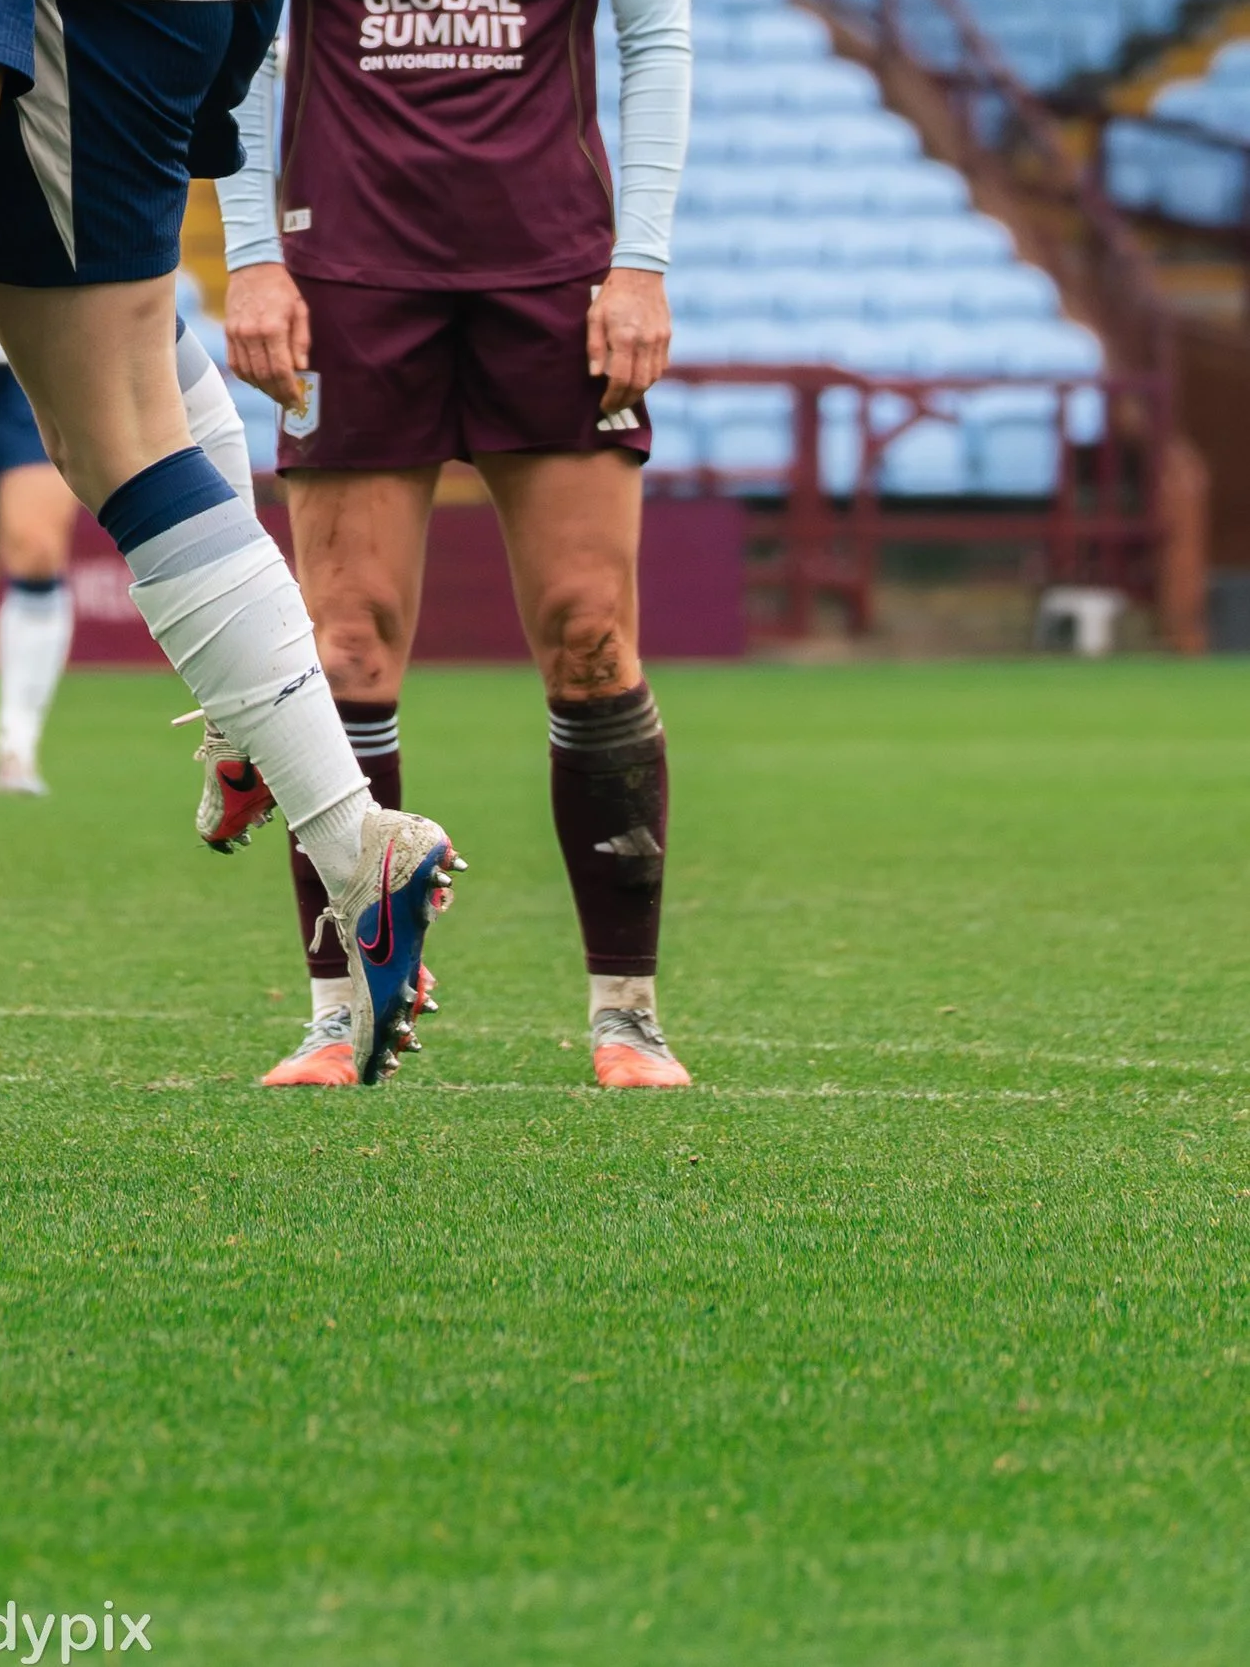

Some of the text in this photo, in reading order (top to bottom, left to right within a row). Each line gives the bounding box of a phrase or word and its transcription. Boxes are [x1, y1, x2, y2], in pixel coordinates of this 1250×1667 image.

[358, 12, 528, 49] SUMMIT
[359, 53, 525, 71] ON WOMEN & SPORT
